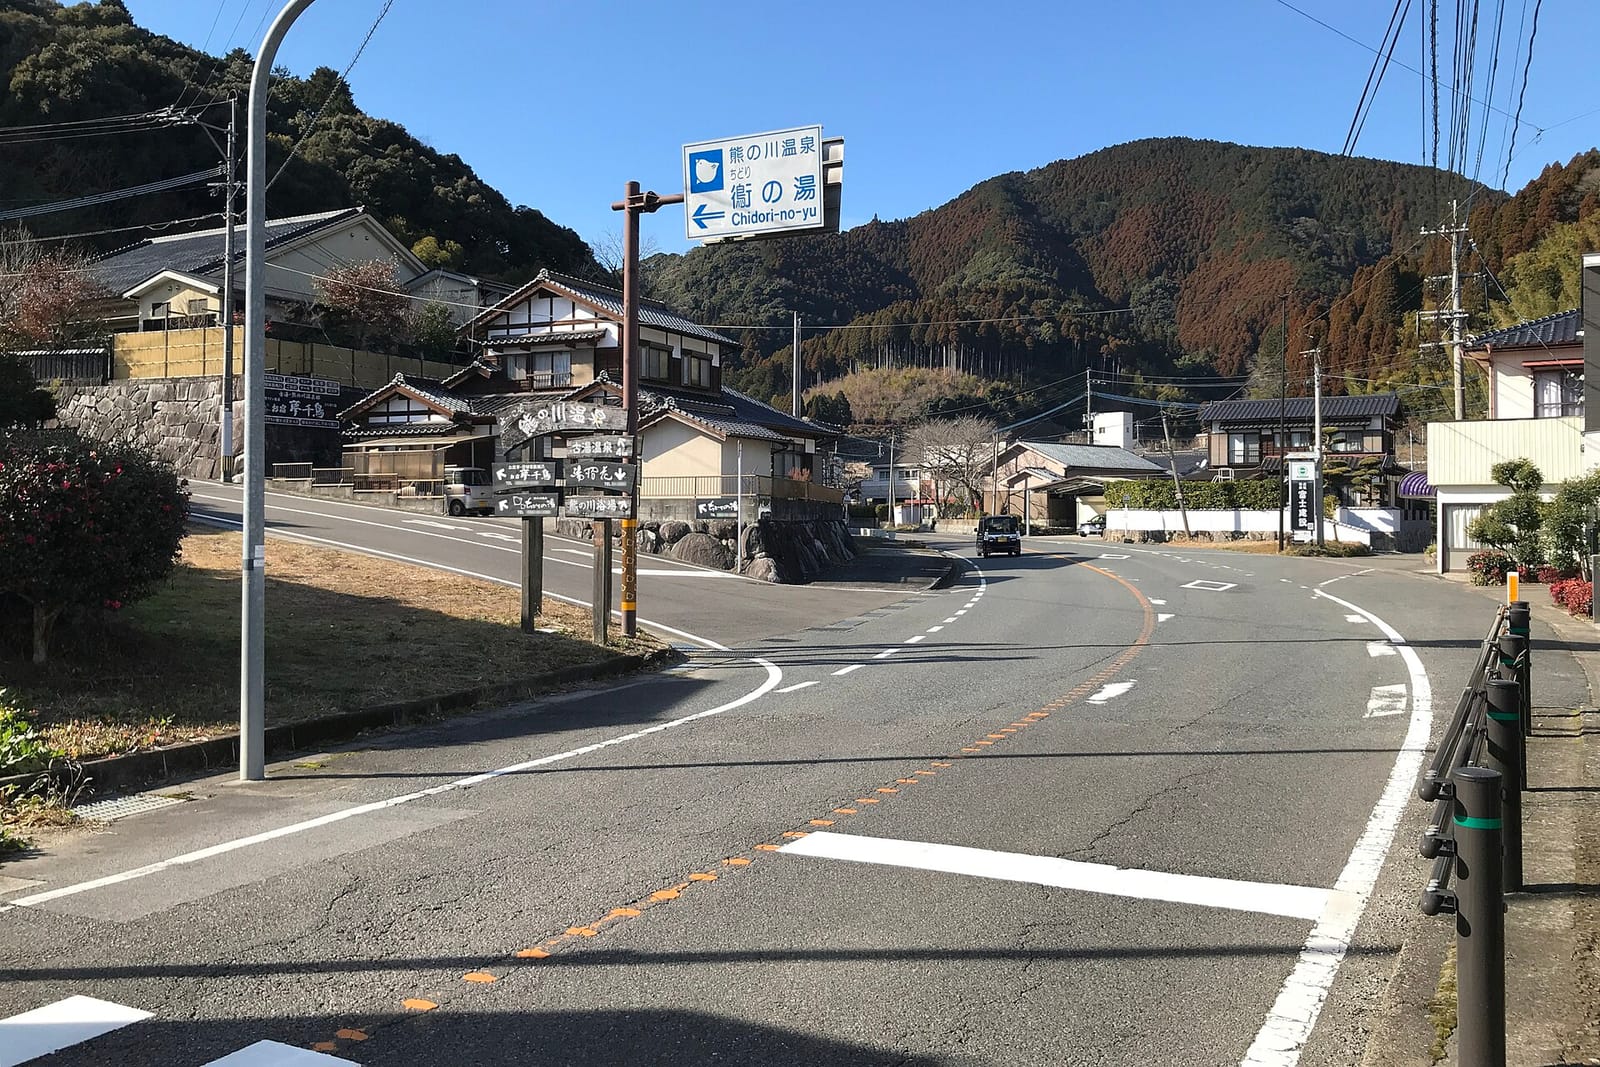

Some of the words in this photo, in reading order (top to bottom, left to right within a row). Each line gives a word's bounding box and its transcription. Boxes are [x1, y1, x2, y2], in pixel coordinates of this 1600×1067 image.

[729, 136, 816, 164] 熊の川温泉
[730, 166, 751, 180] ちどり
[731, 206, 817, 226] Chidori-no-yu
[572, 441, 613, 454] 古湯温泉
